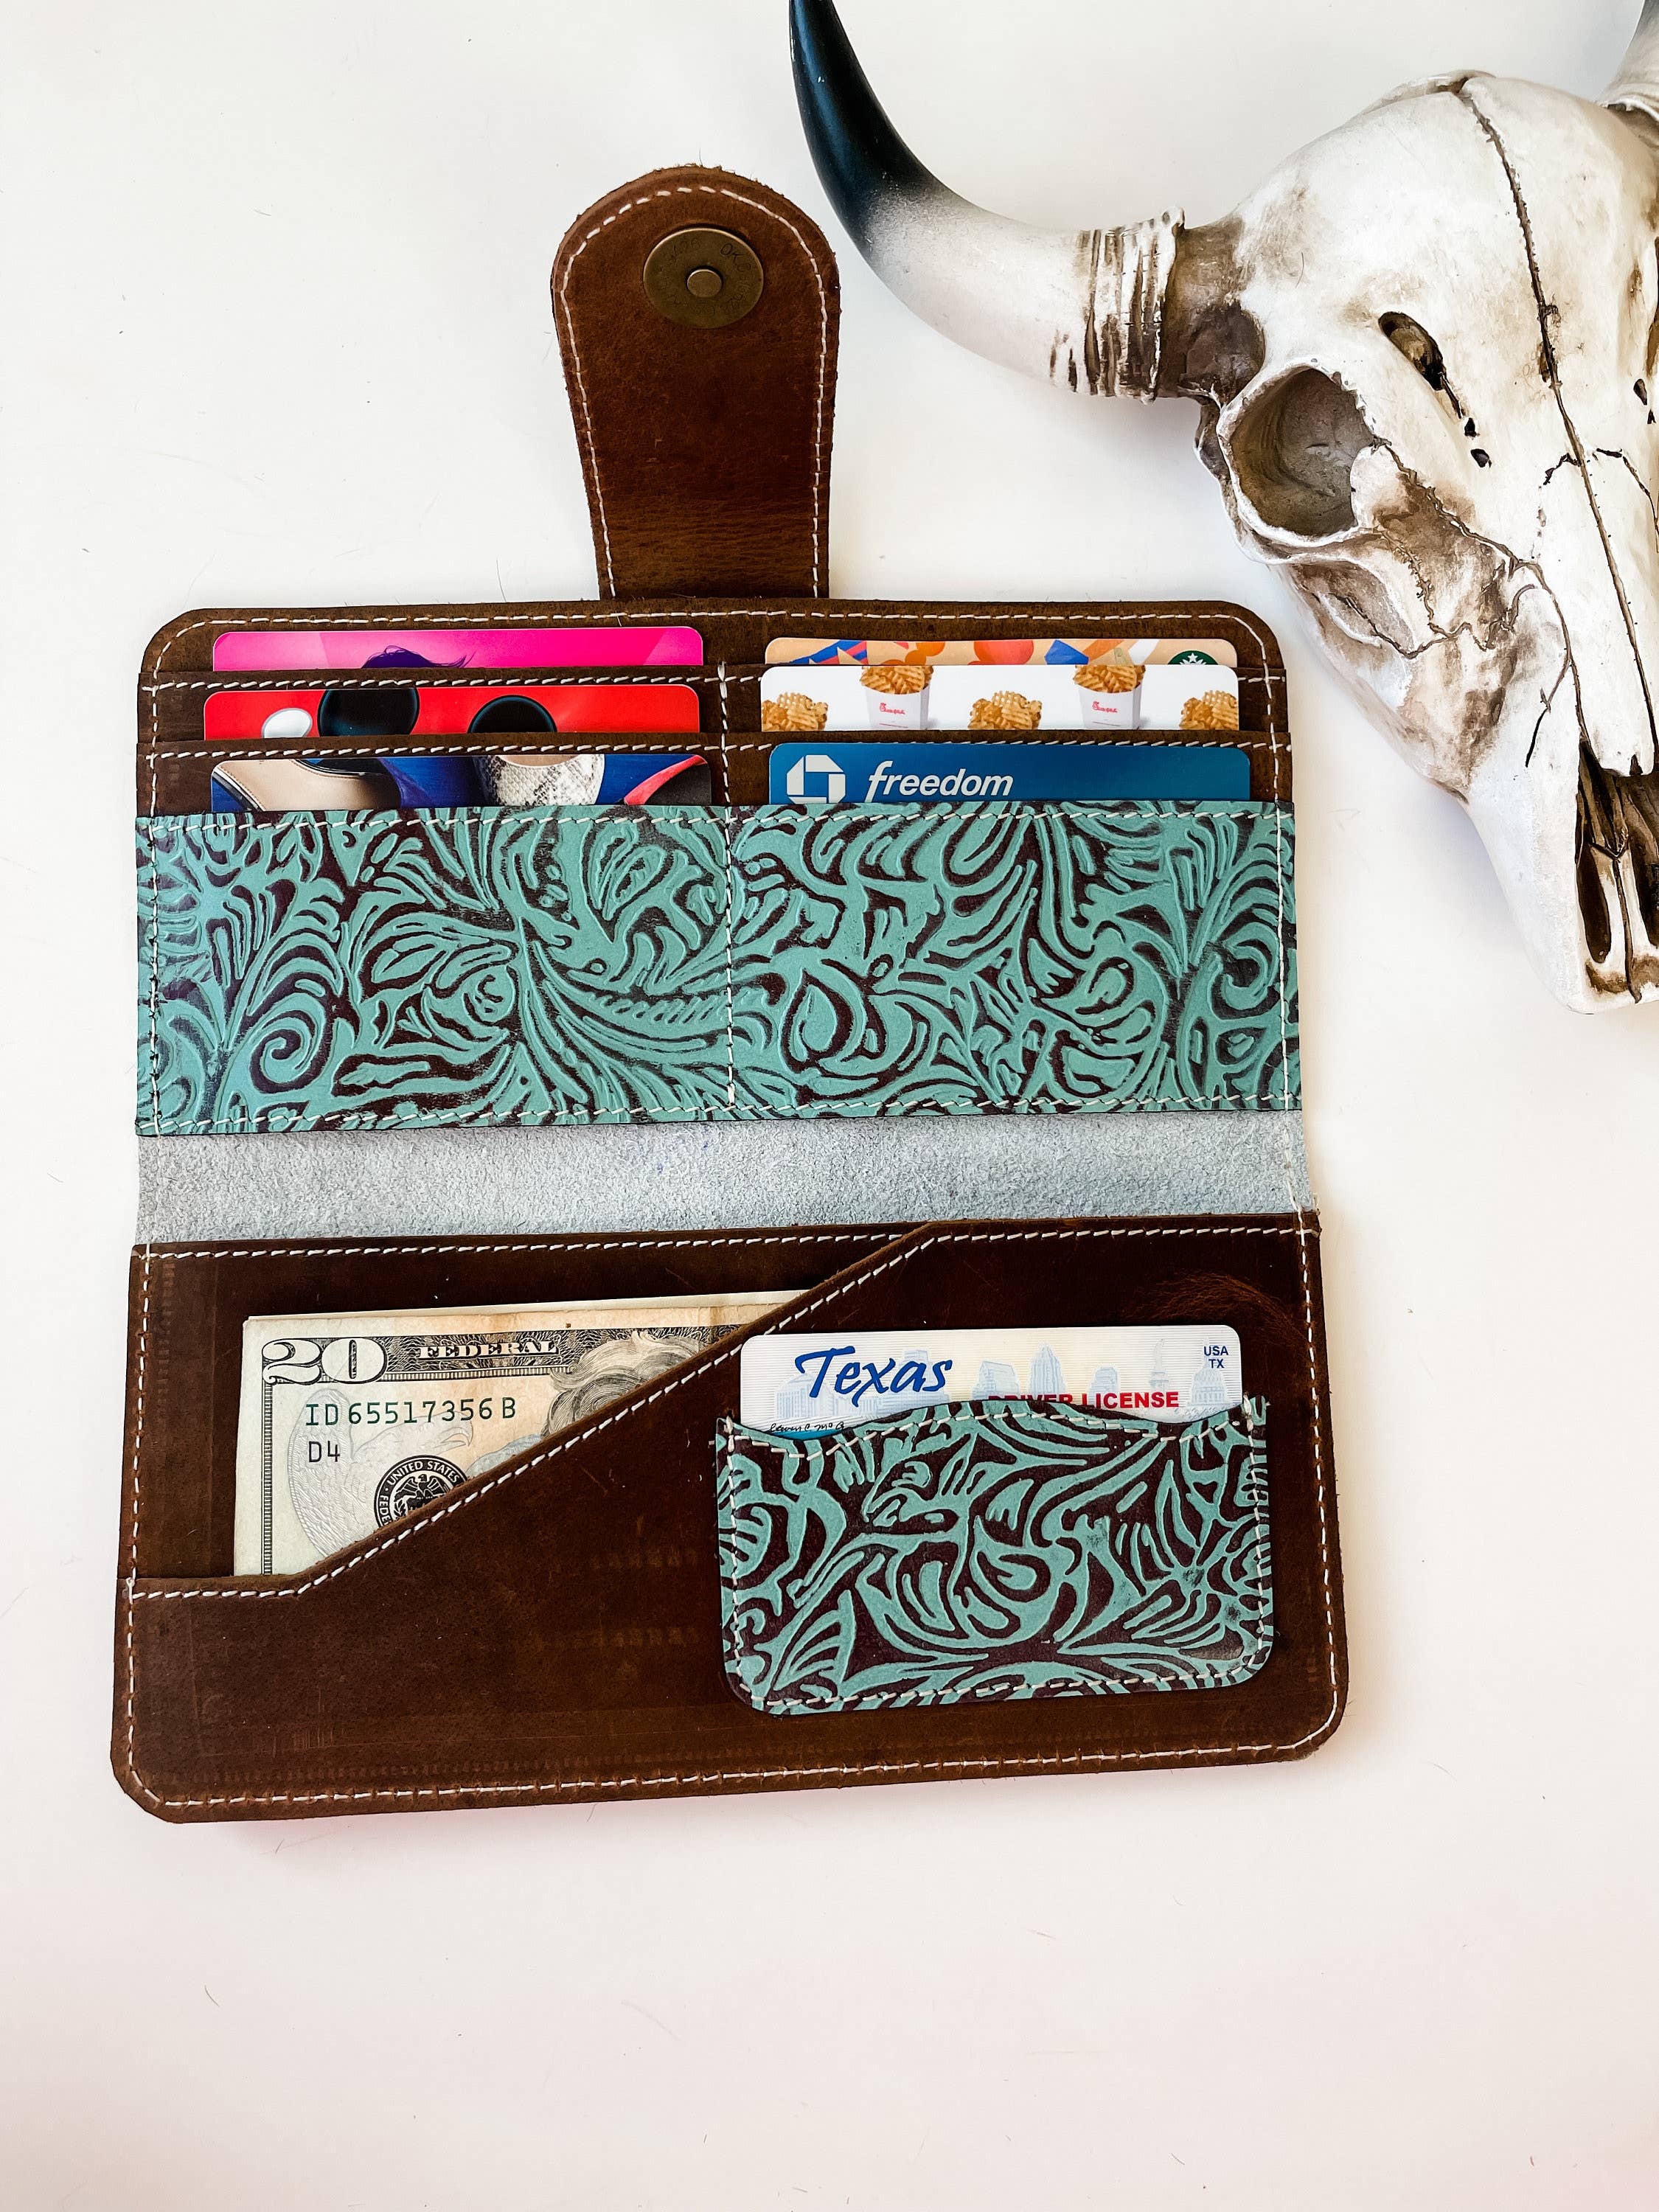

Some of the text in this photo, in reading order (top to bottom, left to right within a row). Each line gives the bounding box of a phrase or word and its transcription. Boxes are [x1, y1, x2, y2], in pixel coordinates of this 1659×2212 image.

[864, 760, 1013, 802] freedom
[419, 1340, 559, 1359] FEDERAL
[1203, 1346, 1228, 1356] USA
[262, 1337, 388, 1385] 20
[1208, 1359, 1224, 1368] TX
[795, 1346, 953, 1407] Texas
[1082, 1391, 1180, 1409] LICENSE
[308, 1441, 340, 1462] D4
[386, 1461, 460, 1485] UNITED STATES
[379, 1495, 392, 1526] FEDE
